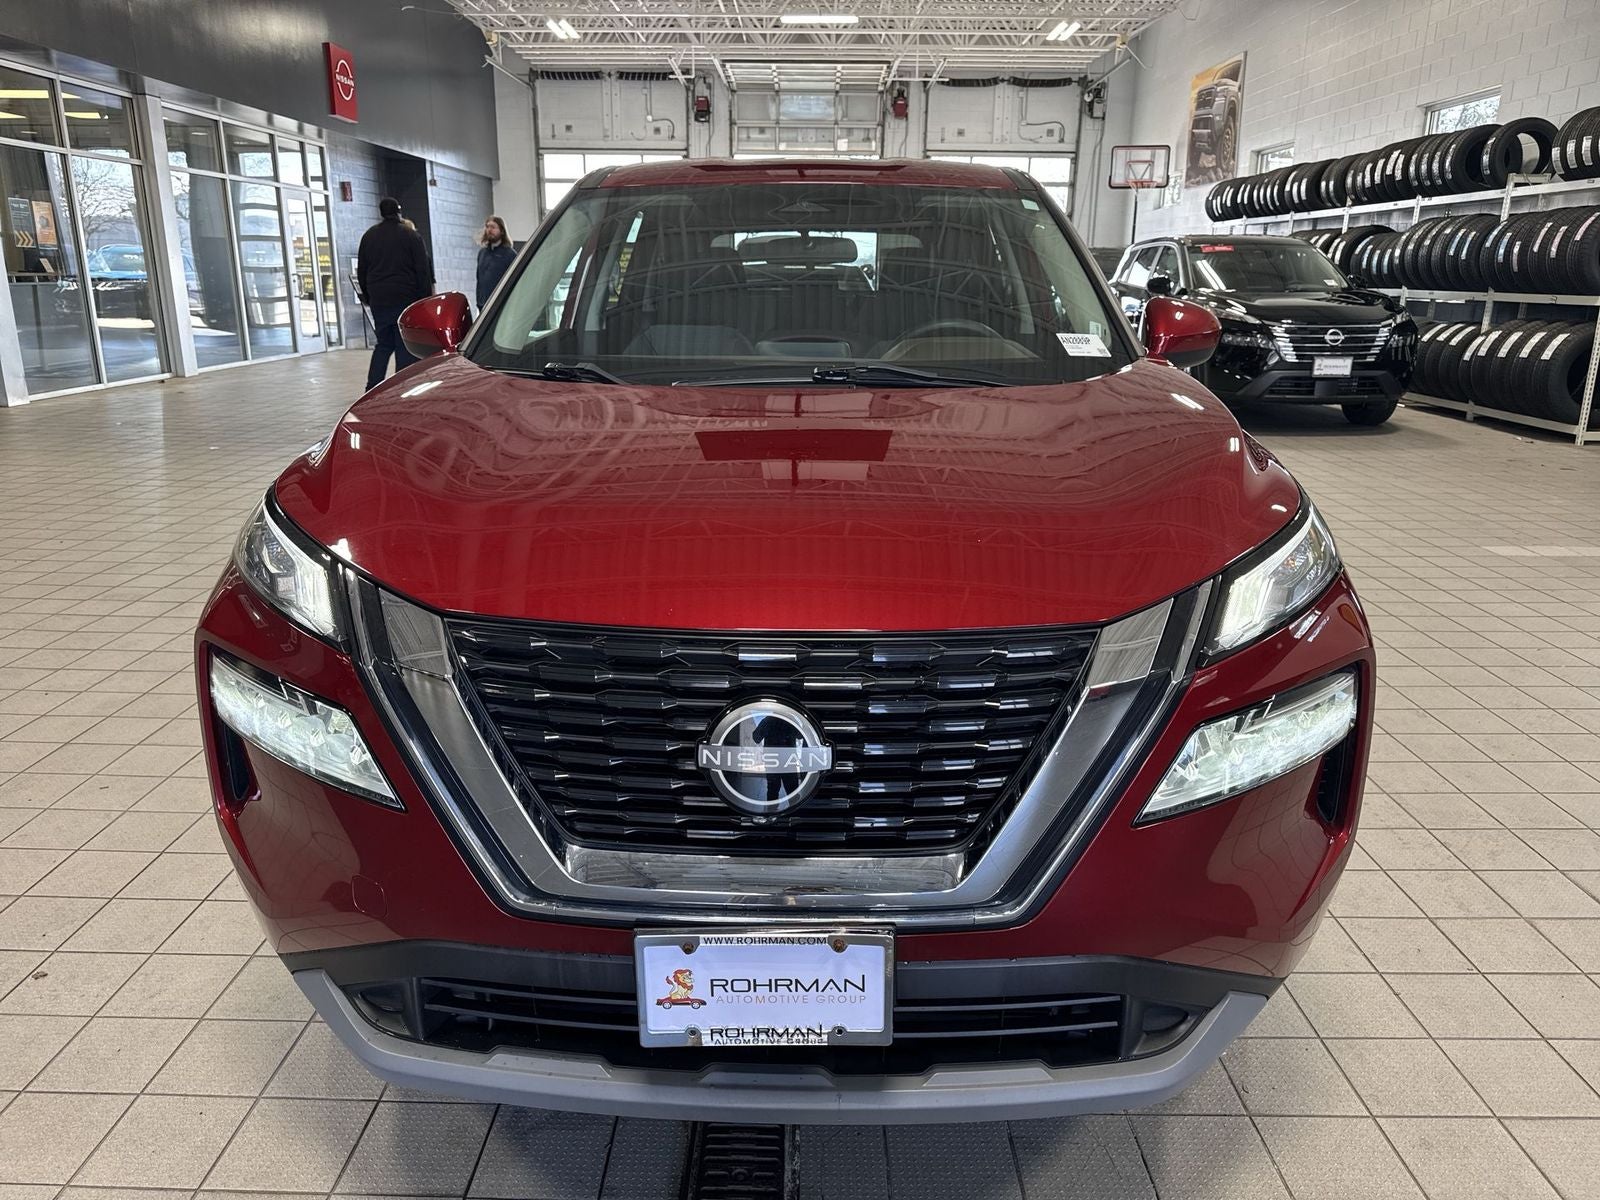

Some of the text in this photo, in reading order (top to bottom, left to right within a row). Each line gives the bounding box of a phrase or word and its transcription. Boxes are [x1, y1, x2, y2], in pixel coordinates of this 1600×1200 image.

[336, 73, 354, 87] NISSAN
[702, 749, 828, 768] NISSAN
[703, 936, 827, 945] WWW.ROHRMAN.COM
[710, 974, 866, 997] ROHRMAN
[716, 995, 867, 1004] AUTOMOTIVE GROUP
[710, 1024, 822, 1040] ROHRMAN
